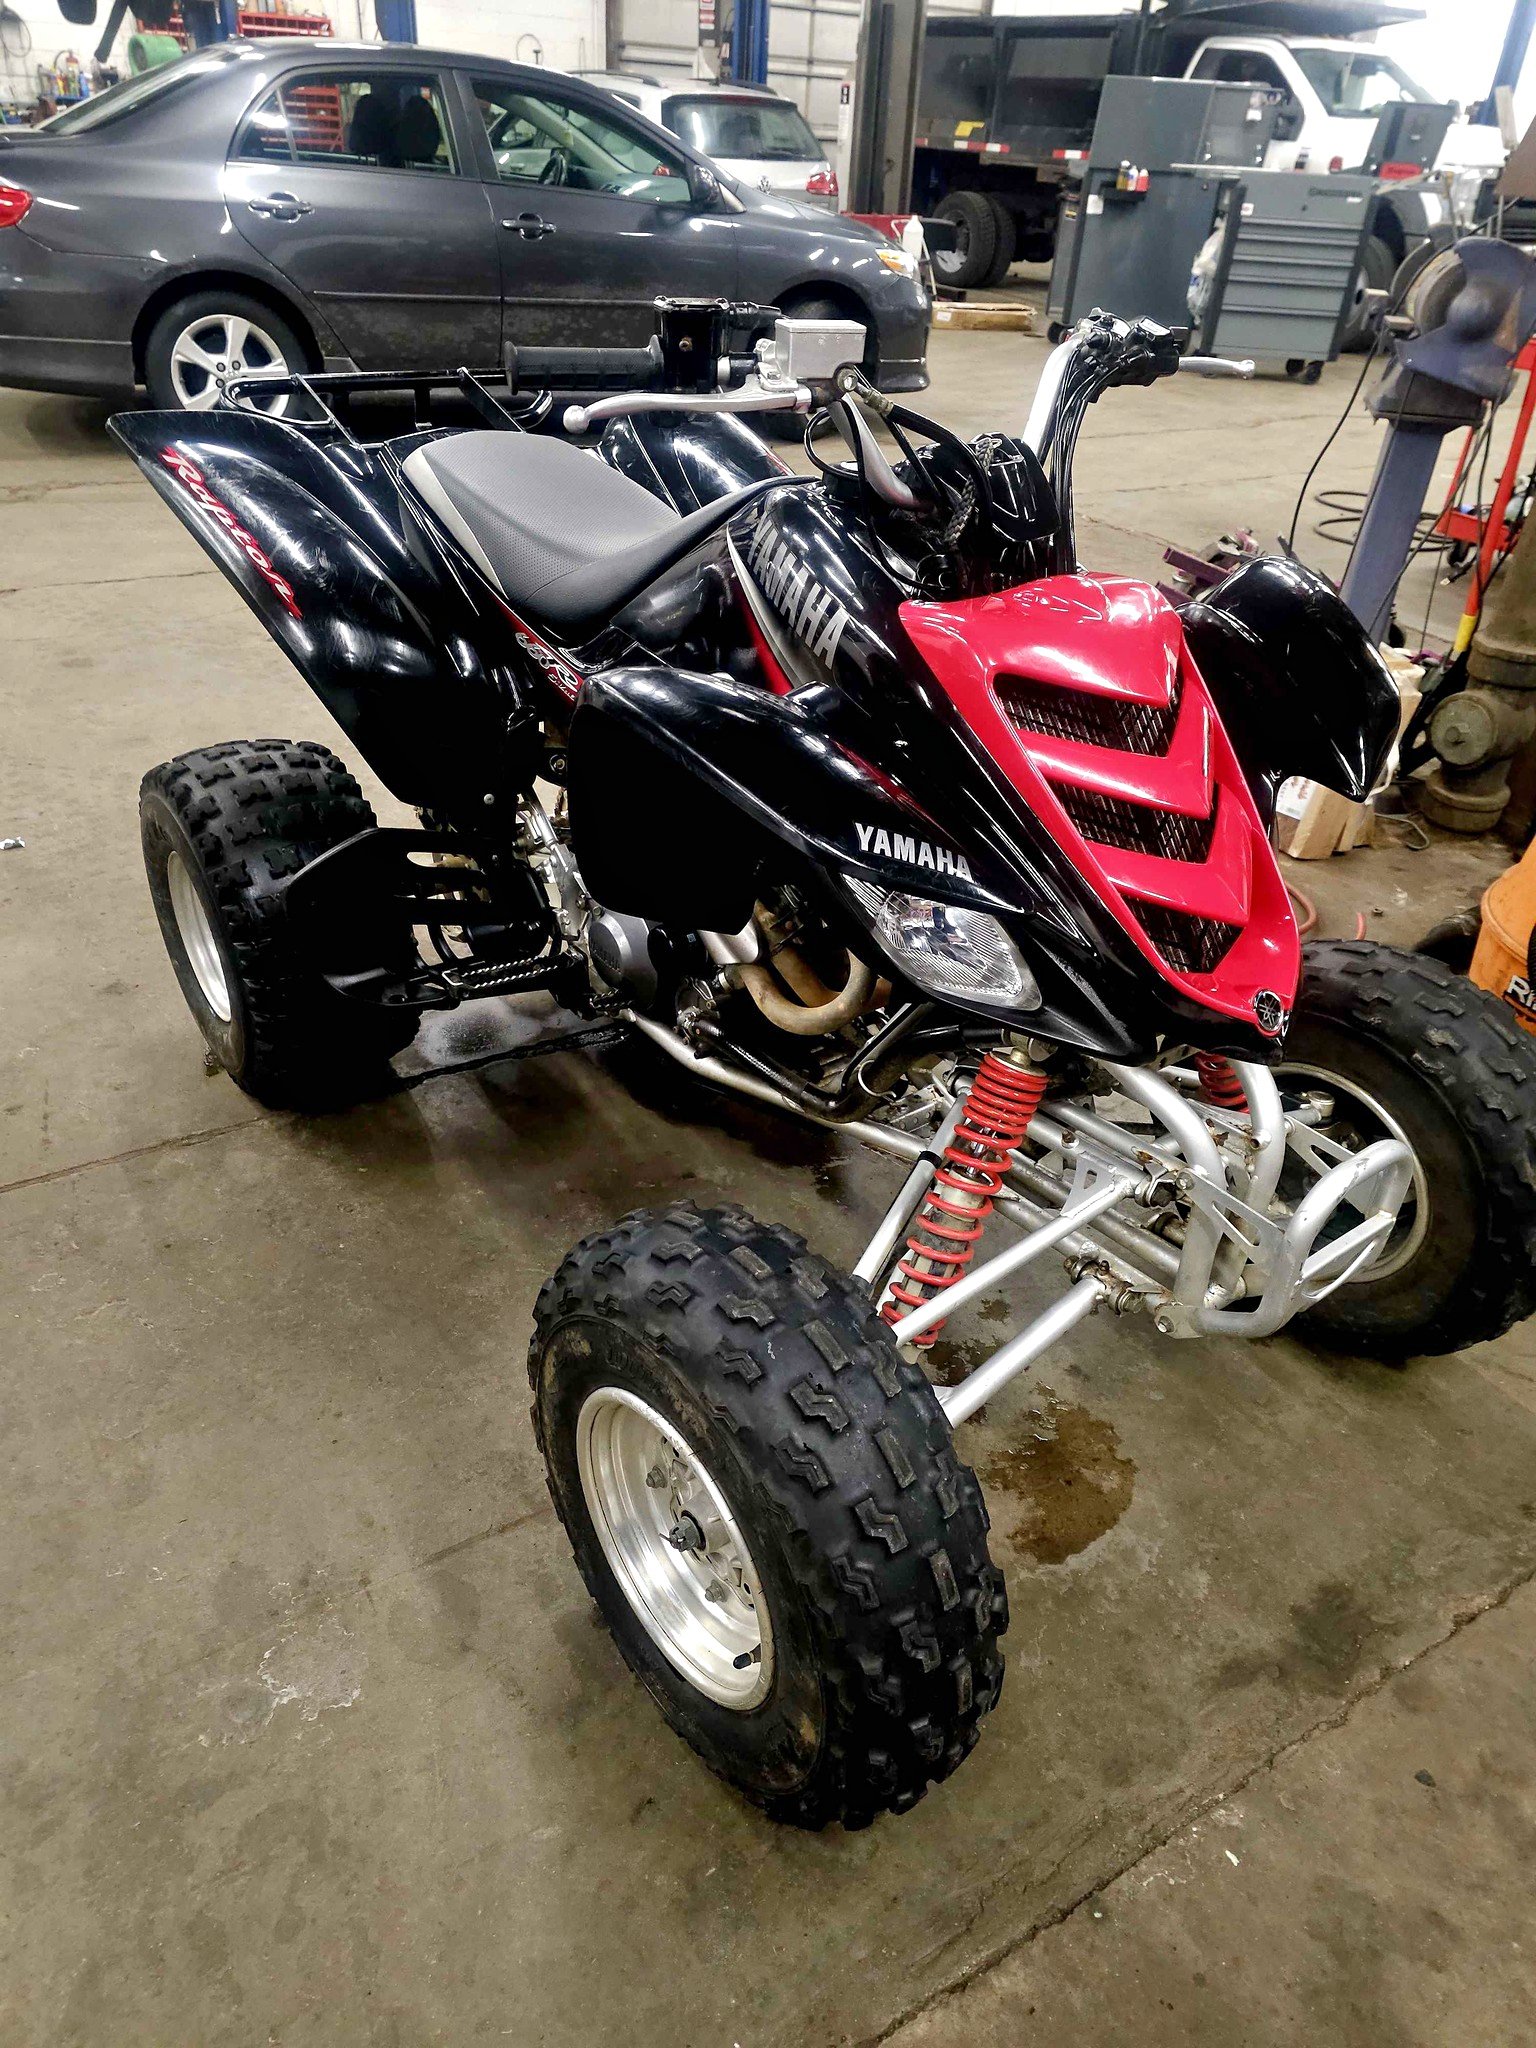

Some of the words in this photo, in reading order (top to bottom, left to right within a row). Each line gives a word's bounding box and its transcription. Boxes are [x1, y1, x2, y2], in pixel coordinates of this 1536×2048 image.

[159, 449, 299, 619] Raptor
[747, 511, 850, 671] YAMAHA
[853, 821, 977, 884] YAMAHA
